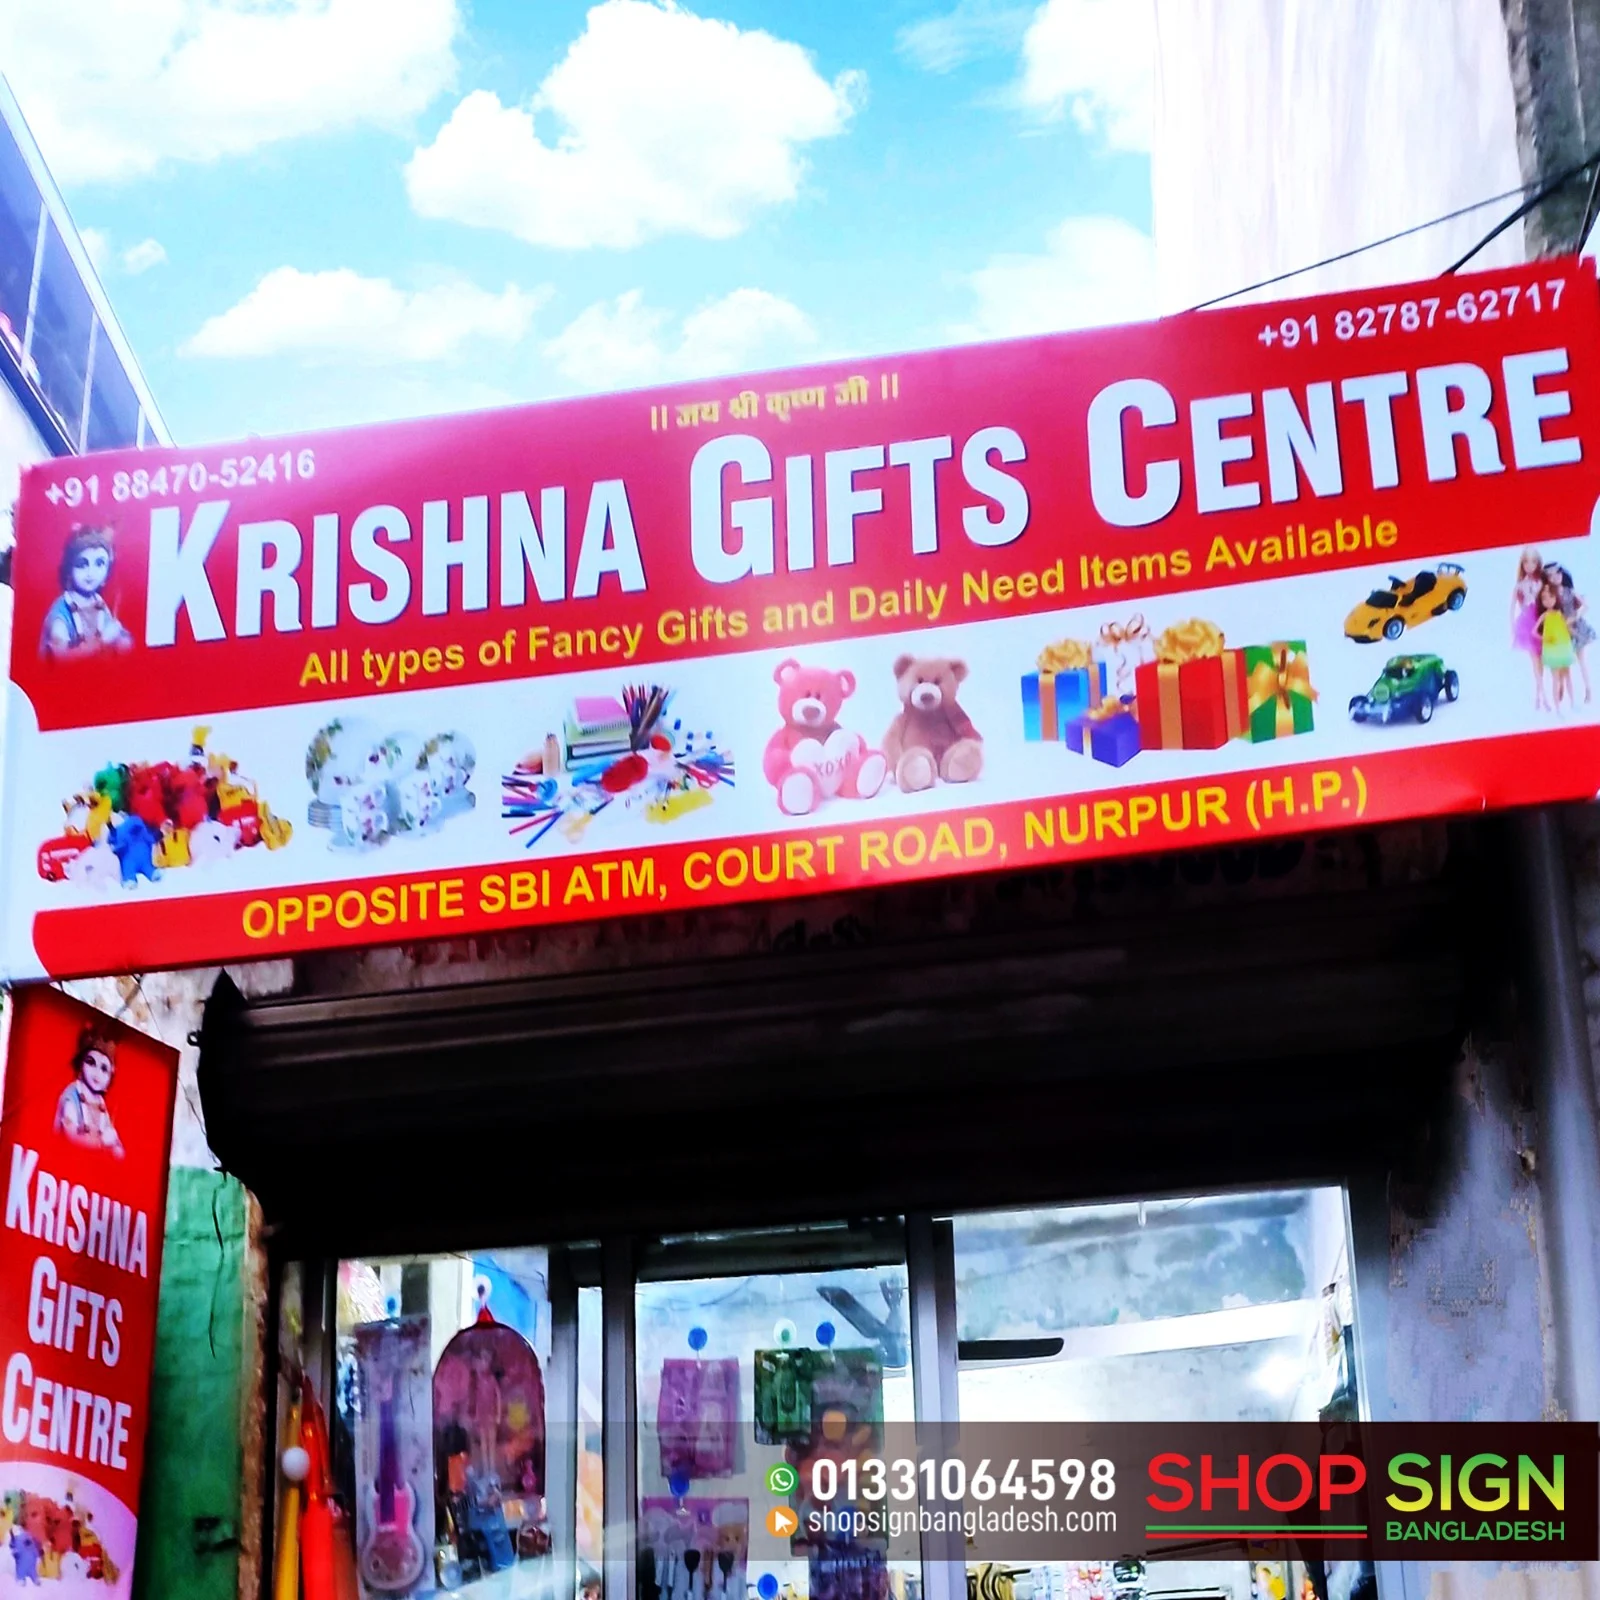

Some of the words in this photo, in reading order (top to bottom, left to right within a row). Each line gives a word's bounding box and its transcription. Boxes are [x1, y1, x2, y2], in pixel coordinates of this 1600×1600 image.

[1257, 315, 1319, 347] +91
[1335, 279, 1566, 340] 82787-62717
[676, 400, 721, 427] जय
[728, 390, 760, 420] श्री
[765, 386, 828, 423] कृष्ण
[834, 375, 869, 405] जी
[45, 477, 99, 507] +91
[112, 448, 317, 503] 88470-52416
[145, 479, 647, 648] KRISHNA
[690, 426, 1029, 584] GIFTS
[1087, 348, 1582, 527] CENTRE
[299, 652, 349, 686] All
[362, 646, 465, 689] types
[478, 630, 516, 666] of
[528, 622, 643, 664] Fancy
[657, 609, 747, 645] Gifts
[765, 594, 834, 632] and
[850, 580, 947, 621] Daily
[962, 559, 1065, 605] Need
[1079, 548, 1192, 589] Items
[1205, 515, 1398, 572] Available
[242, 878, 465, 939] OPPOSITE
[479, 869, 550, 914] SBI
[563, 857, 668, 905] ATM,
[683, 835, 844, 891] COURT
[859, 818, 1008, 870] ROAD,
[1023, 786, 1230, 849] NURPUR
[1245, 767, 1369, 830] (H.P.)
[5, 1143, 148, 1279] KRISHNA
[27, 1256, 123, 1368] GIFTS
[1, 1352, 132, 1471] CENTRE
